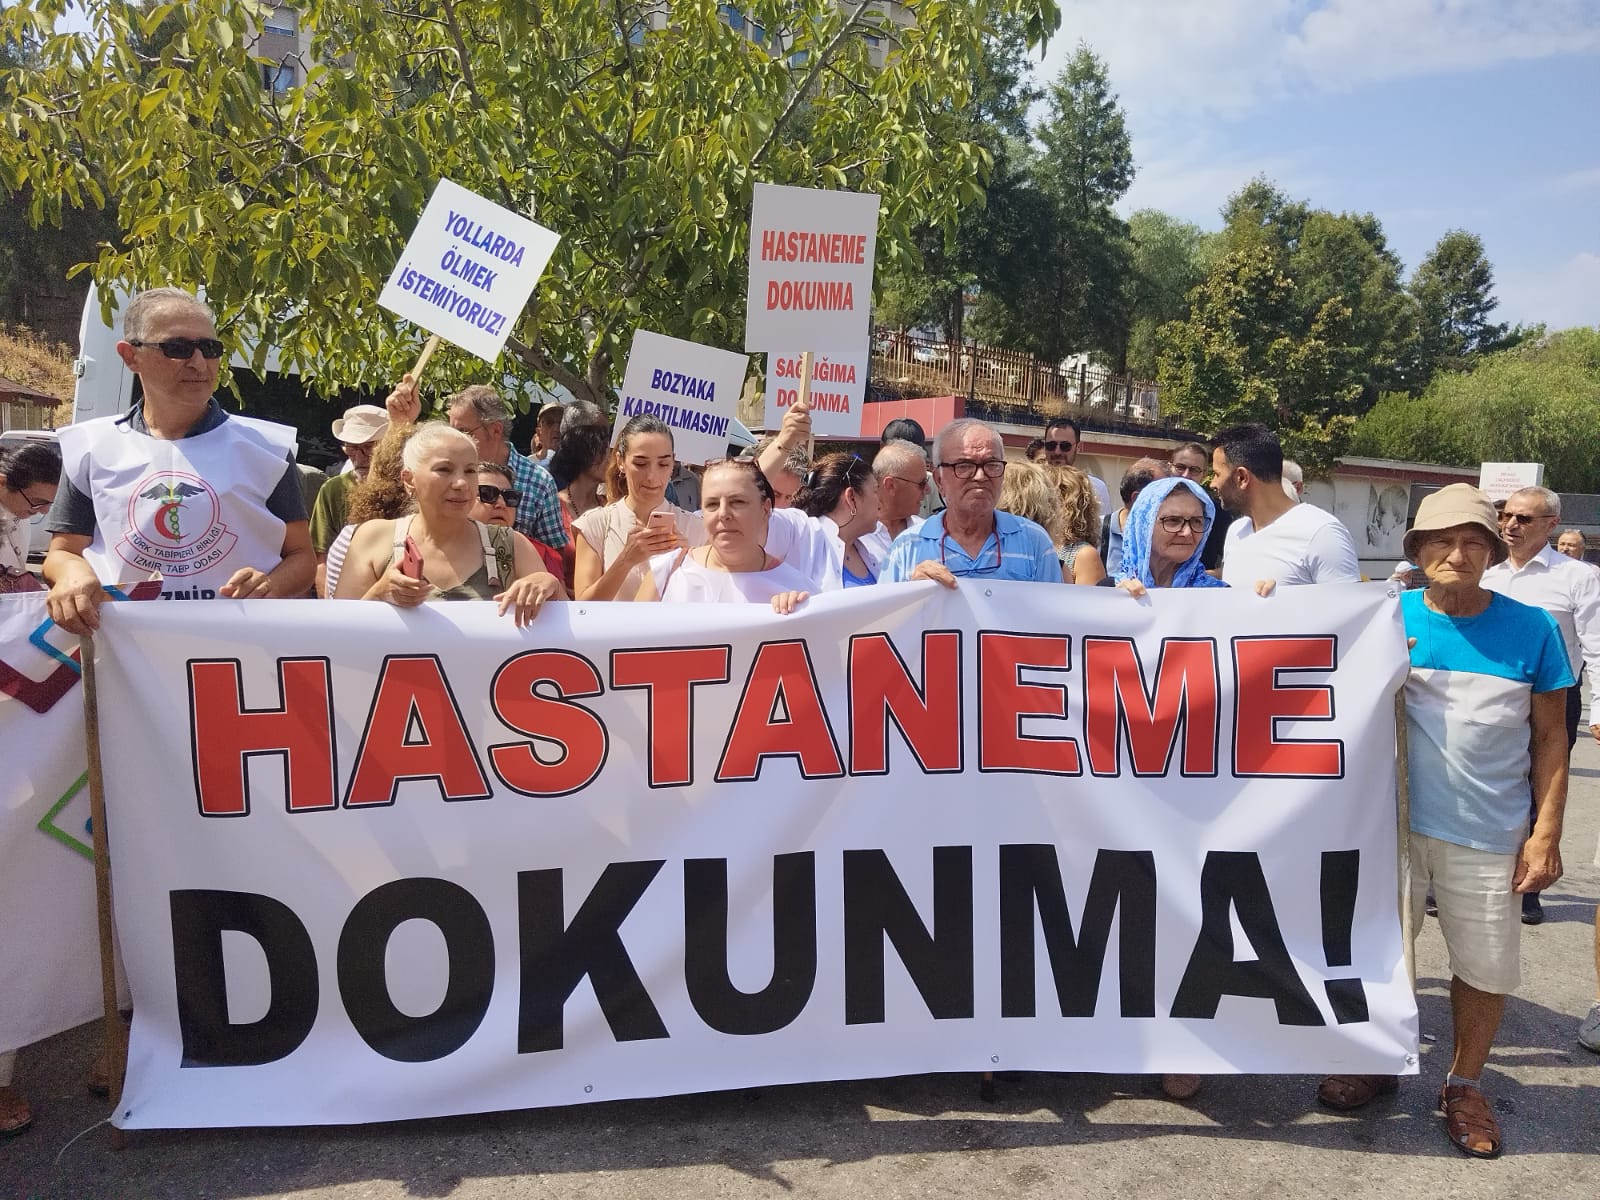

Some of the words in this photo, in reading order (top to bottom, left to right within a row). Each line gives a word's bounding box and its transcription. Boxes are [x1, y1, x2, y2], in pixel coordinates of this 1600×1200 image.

[444, 210, 526, 268] YOLLARDA
[761, 230, 867, 264] HASTANEME
[441, 244, 498, 292] ÖLMEK
[397, 262, 507, 337] İSTEMİYORUZ!
[766, 280, 854, 311] DOKUNMA
[651, 368, 715, 402] BOZYAKA
[775, 354, 856, 384] SAĞIĞIMA
[623, 396, 730, 438] KAPATILMASIN!
[776, 388, 850, 414] DOUNMA
[133, 554, 162, 571] İZMİR
[193, 548, 223, 569] ODASI
[185, 629, 1346, 818] HASTANEME
[169, 844, 1370, 1069] DOKUNMA!
